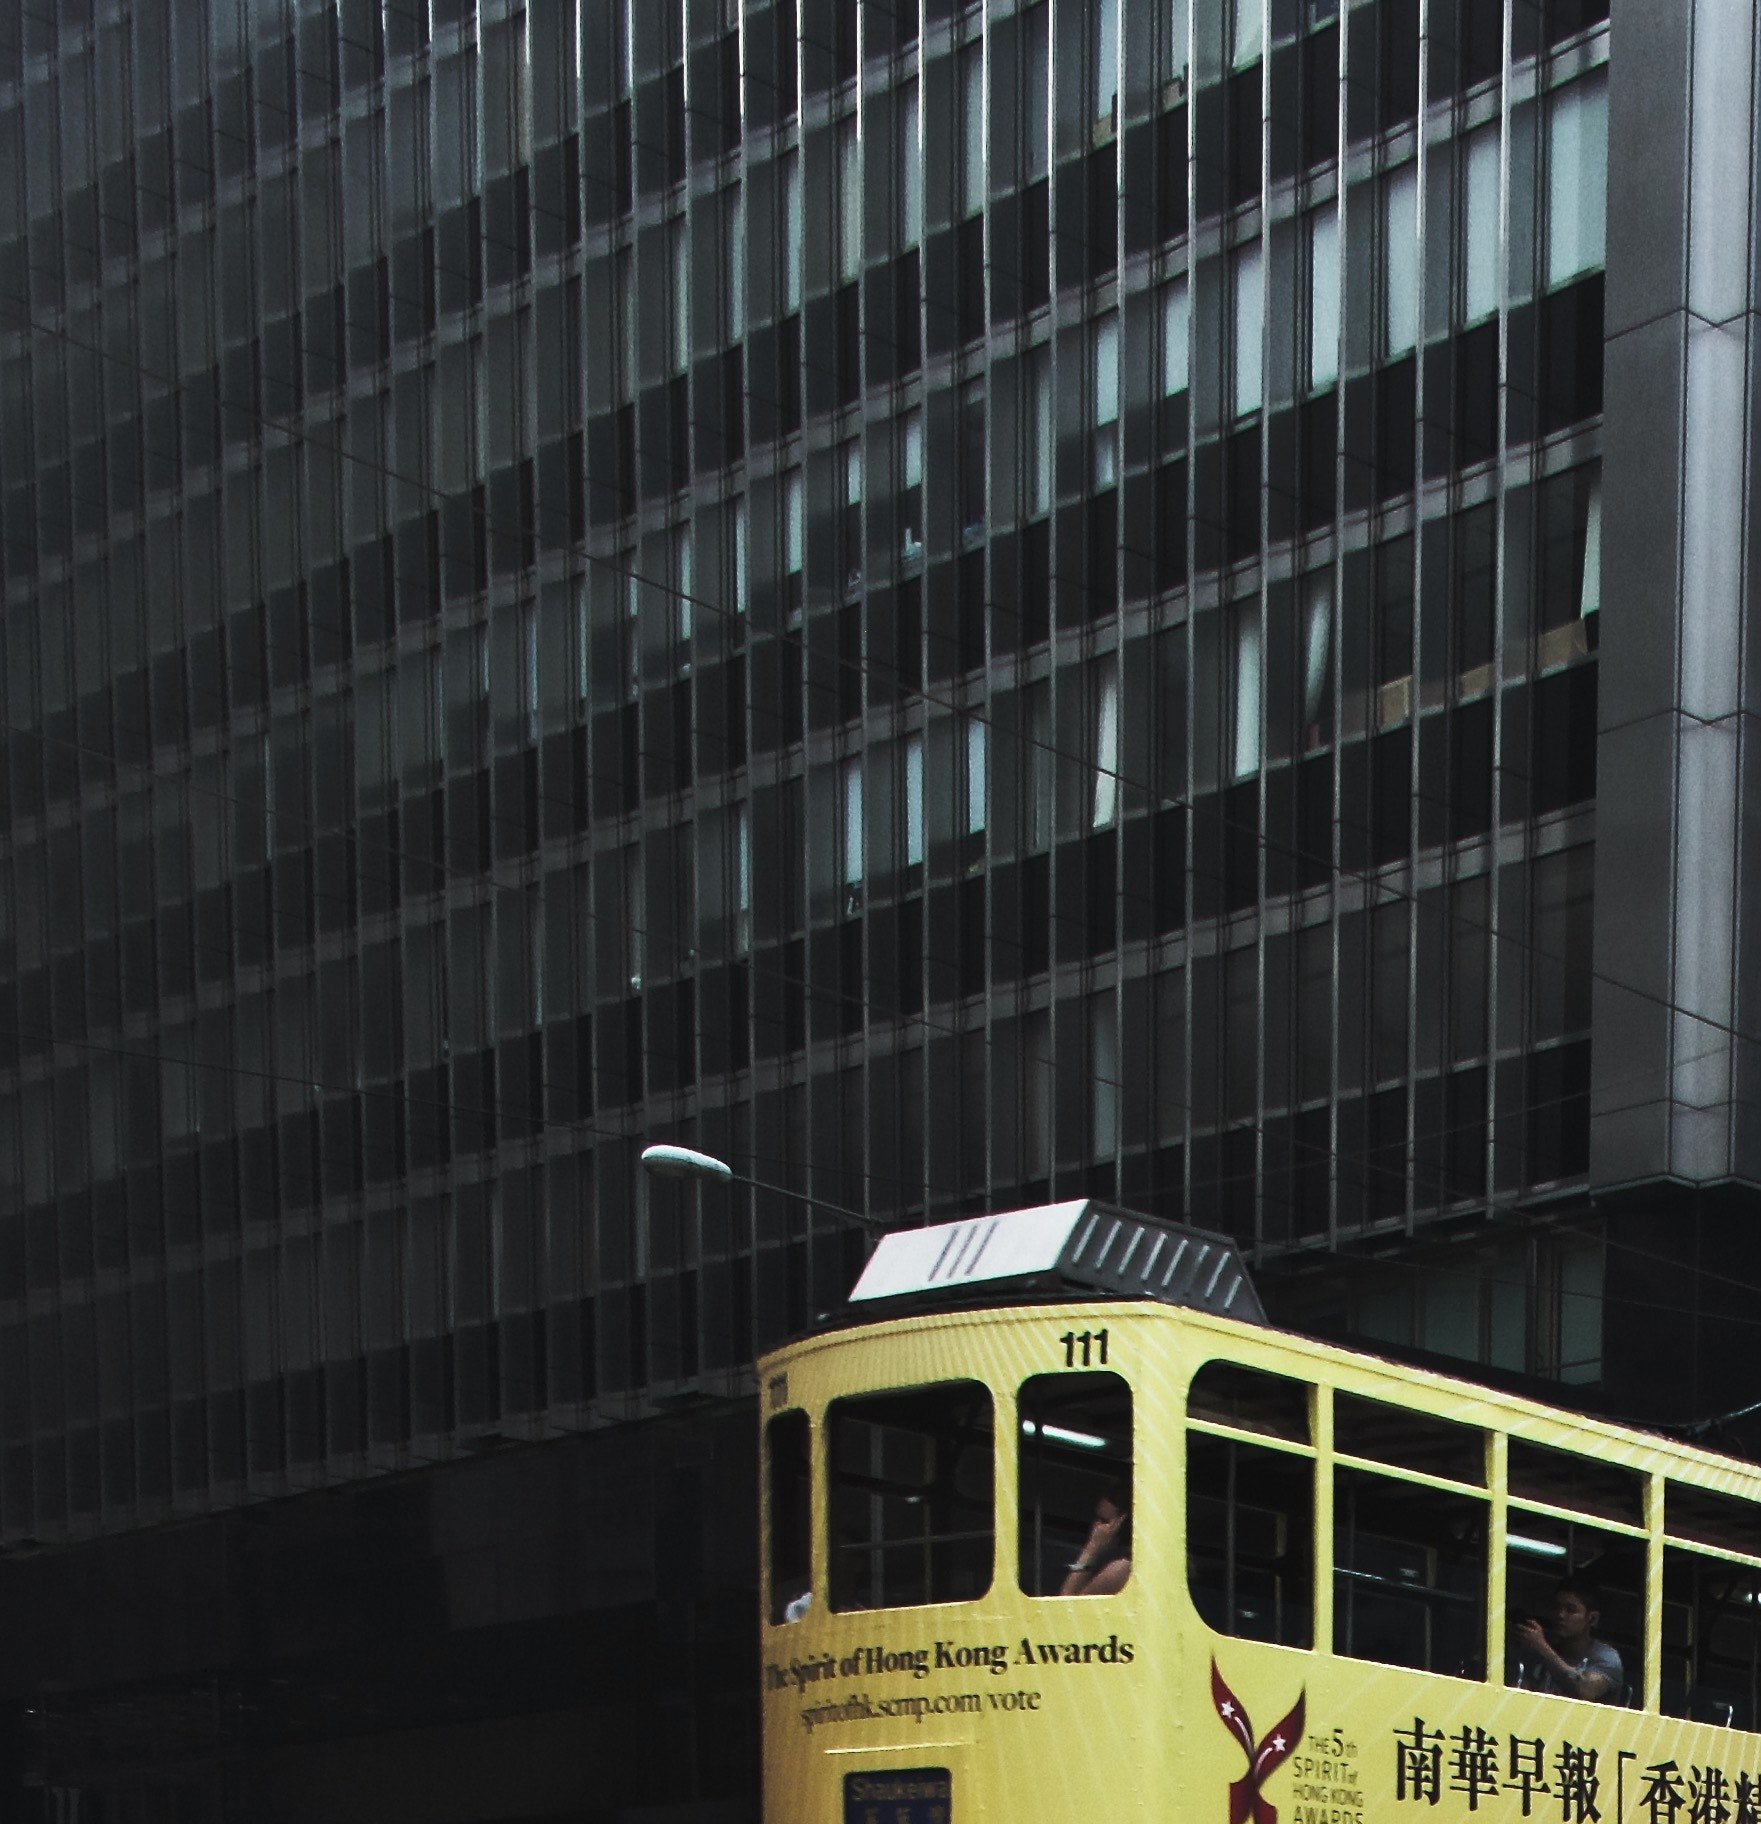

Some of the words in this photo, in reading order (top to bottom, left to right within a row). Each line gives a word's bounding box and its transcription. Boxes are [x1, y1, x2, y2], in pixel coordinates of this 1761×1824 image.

[1061, 1328, 1109, 1369] 111
[790, 1653, 838, 1694] Spirit
[839, 1647, 863, 1678] of
[866, 1646, 930, 1680] Hong
[934, 1641, 1009, 1676] Kong
[1012, 1635, 1135, 1665] Awards
[1293, 1756, 1348, 1783] SPIRIT
[1293, 1784, 1328, 1803] HONG
[1330, 1788, 1363, 1808] KONG
